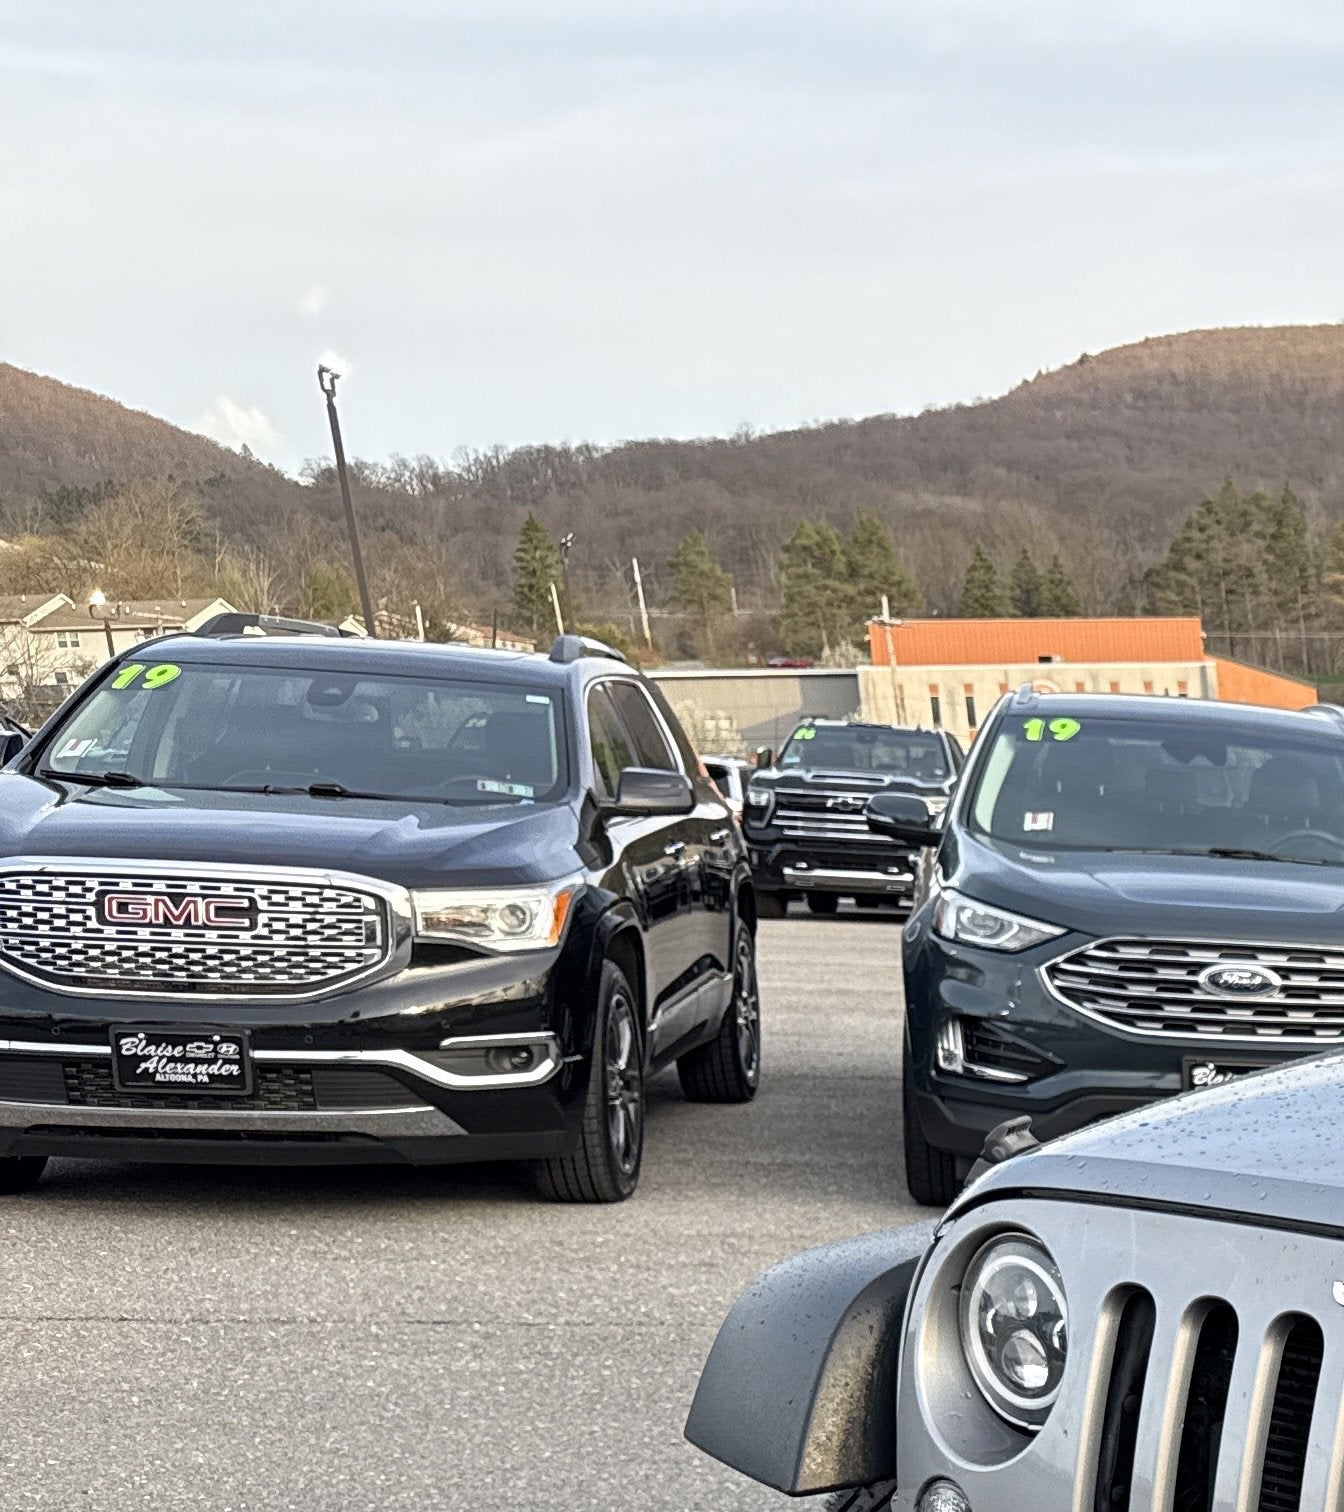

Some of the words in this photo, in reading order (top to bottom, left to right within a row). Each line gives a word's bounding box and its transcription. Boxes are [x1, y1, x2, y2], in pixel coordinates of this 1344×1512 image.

[111, 664, 182, 689] 19
[1023, 717, 1081, 741] 19
[105, 894, 250, 927] GMC
[1219, 971, 1263, 989] Ford
[119, 1037, 185, 1057] Blaise
[135, 1055, 241, 1075] Alexander
[197, 1074, 210, 1083] PA
